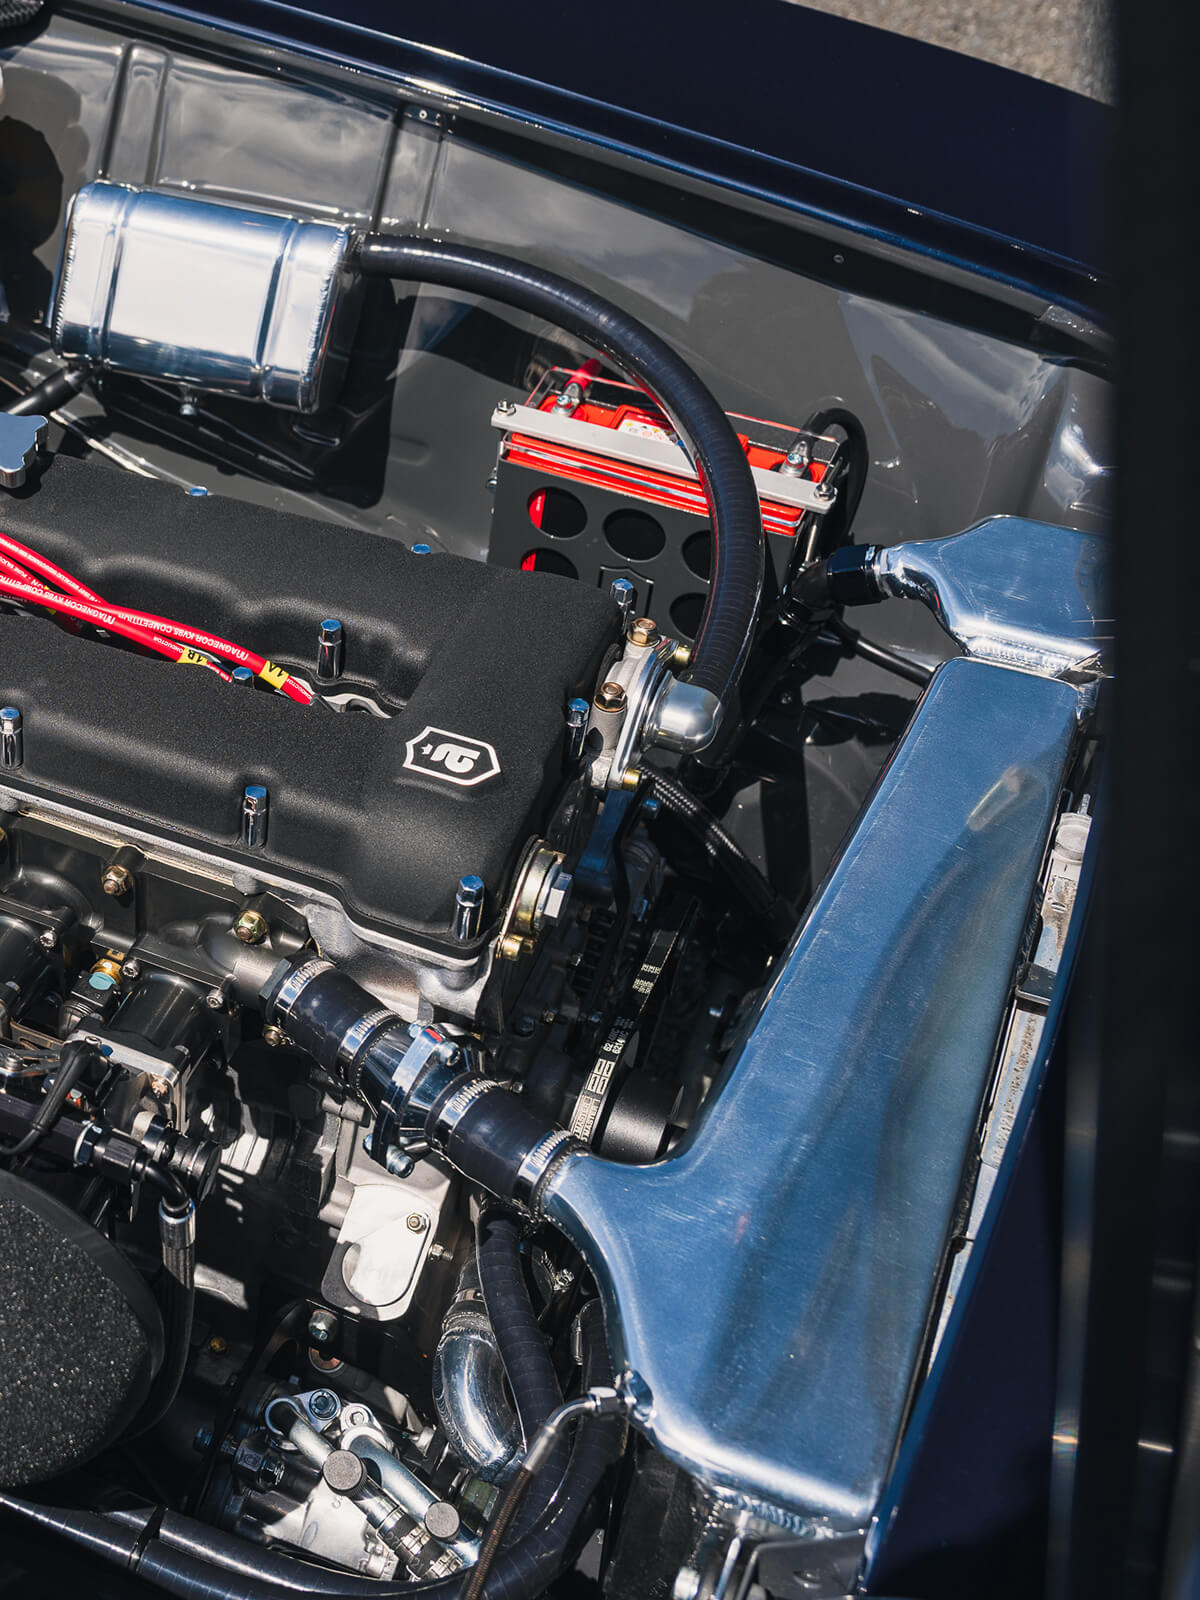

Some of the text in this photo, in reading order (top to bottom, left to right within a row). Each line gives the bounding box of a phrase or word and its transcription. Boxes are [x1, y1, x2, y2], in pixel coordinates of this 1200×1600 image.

[63, 598, 115, 624] MAGNECOR
[172, 626, 194, 640] KV85
[153, 636, 184, 654] ONDUCTOR
[195, 634, 248, 661] MAGNECOR
